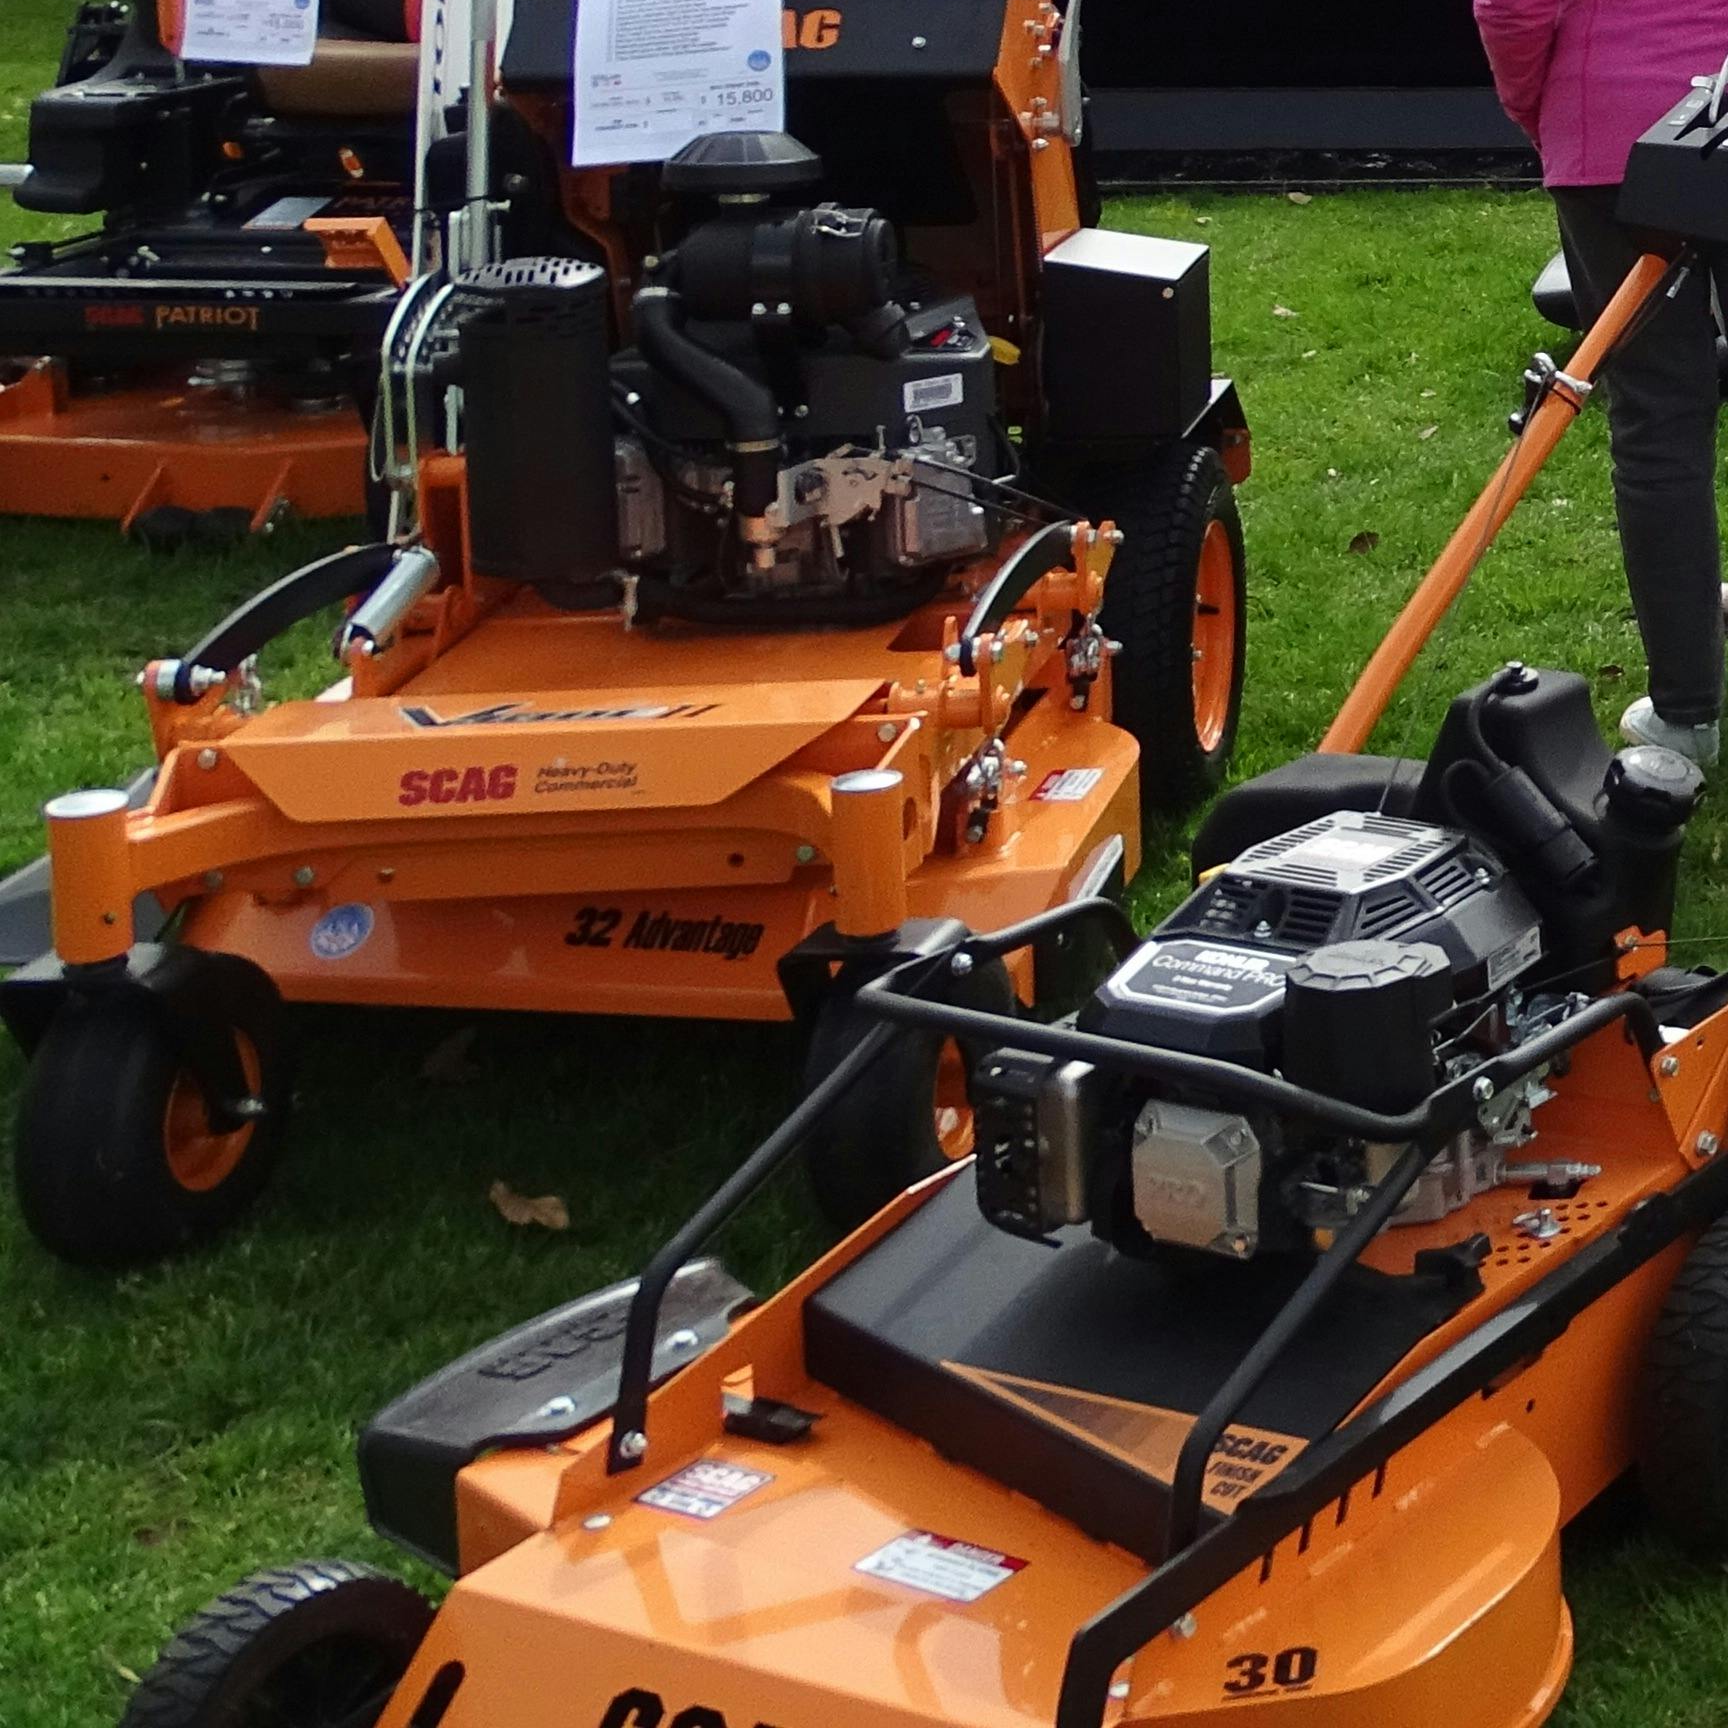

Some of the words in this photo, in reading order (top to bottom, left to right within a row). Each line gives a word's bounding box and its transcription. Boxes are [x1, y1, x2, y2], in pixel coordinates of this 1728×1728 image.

[154, 304, 260, 330] PATRIOT
[537, 761, 639, 780] Heavy-Duty
[397, 763, 519, 807] SCAG
[535, 775, 639, 794] Commercial
[563, 907, 623, 948] 32
[622, 908, 765, 961] Advantage
[1151, 954, 1241, 981] Command
[1220, 1432, 1290, 1466] SCAG
[1206, 1461, 1263, 1483] FINISH
[1209, 1480, 1248, 1498] CUT
[1223, 1646, 1319, 1693] 30
